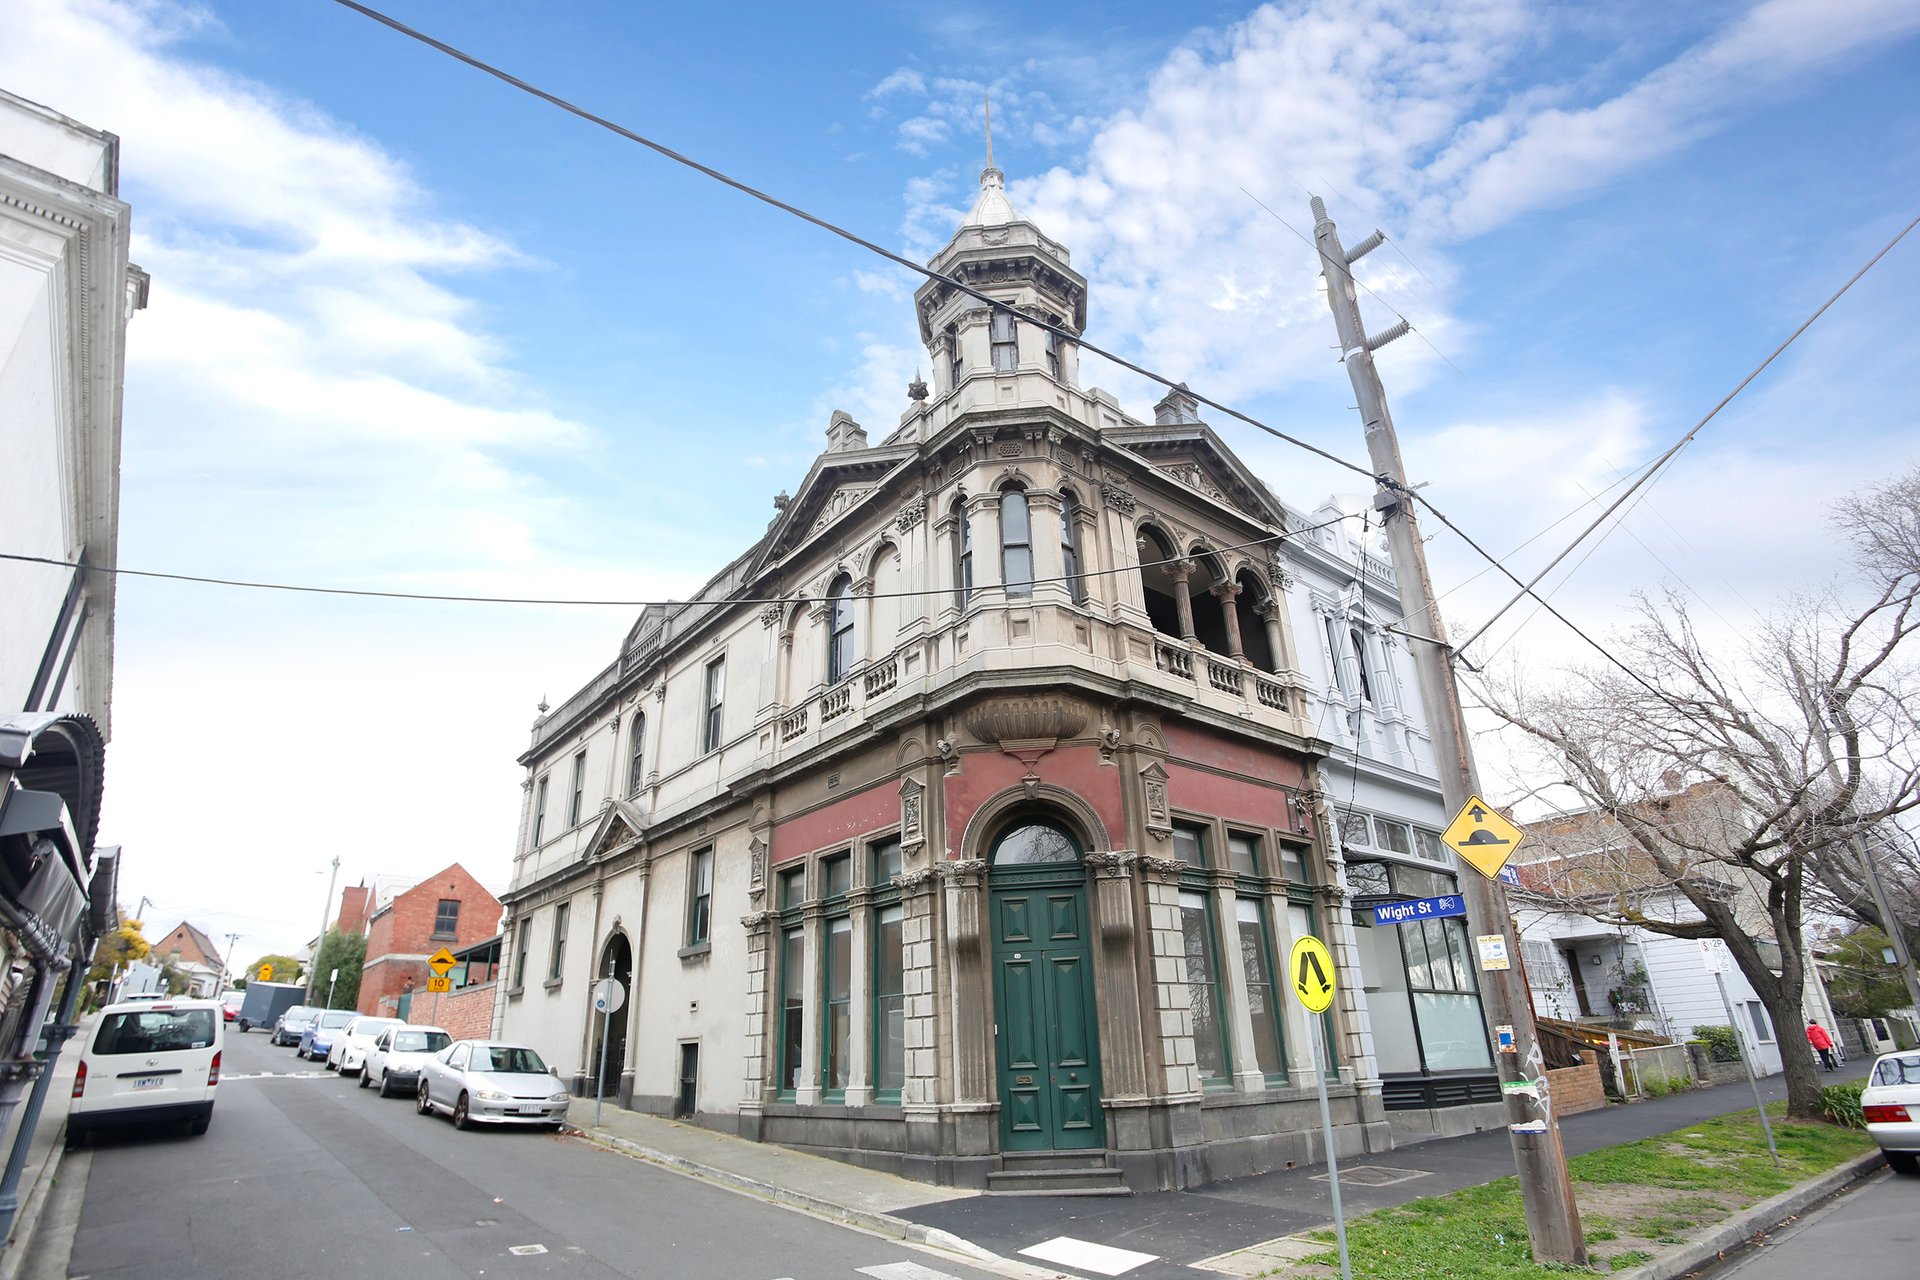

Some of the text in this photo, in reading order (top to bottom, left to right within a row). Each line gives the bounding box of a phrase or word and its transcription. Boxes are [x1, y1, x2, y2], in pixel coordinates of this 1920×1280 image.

[1377, 901, 1432, 920] Wight St
[434, 979, 444, 987] 10
